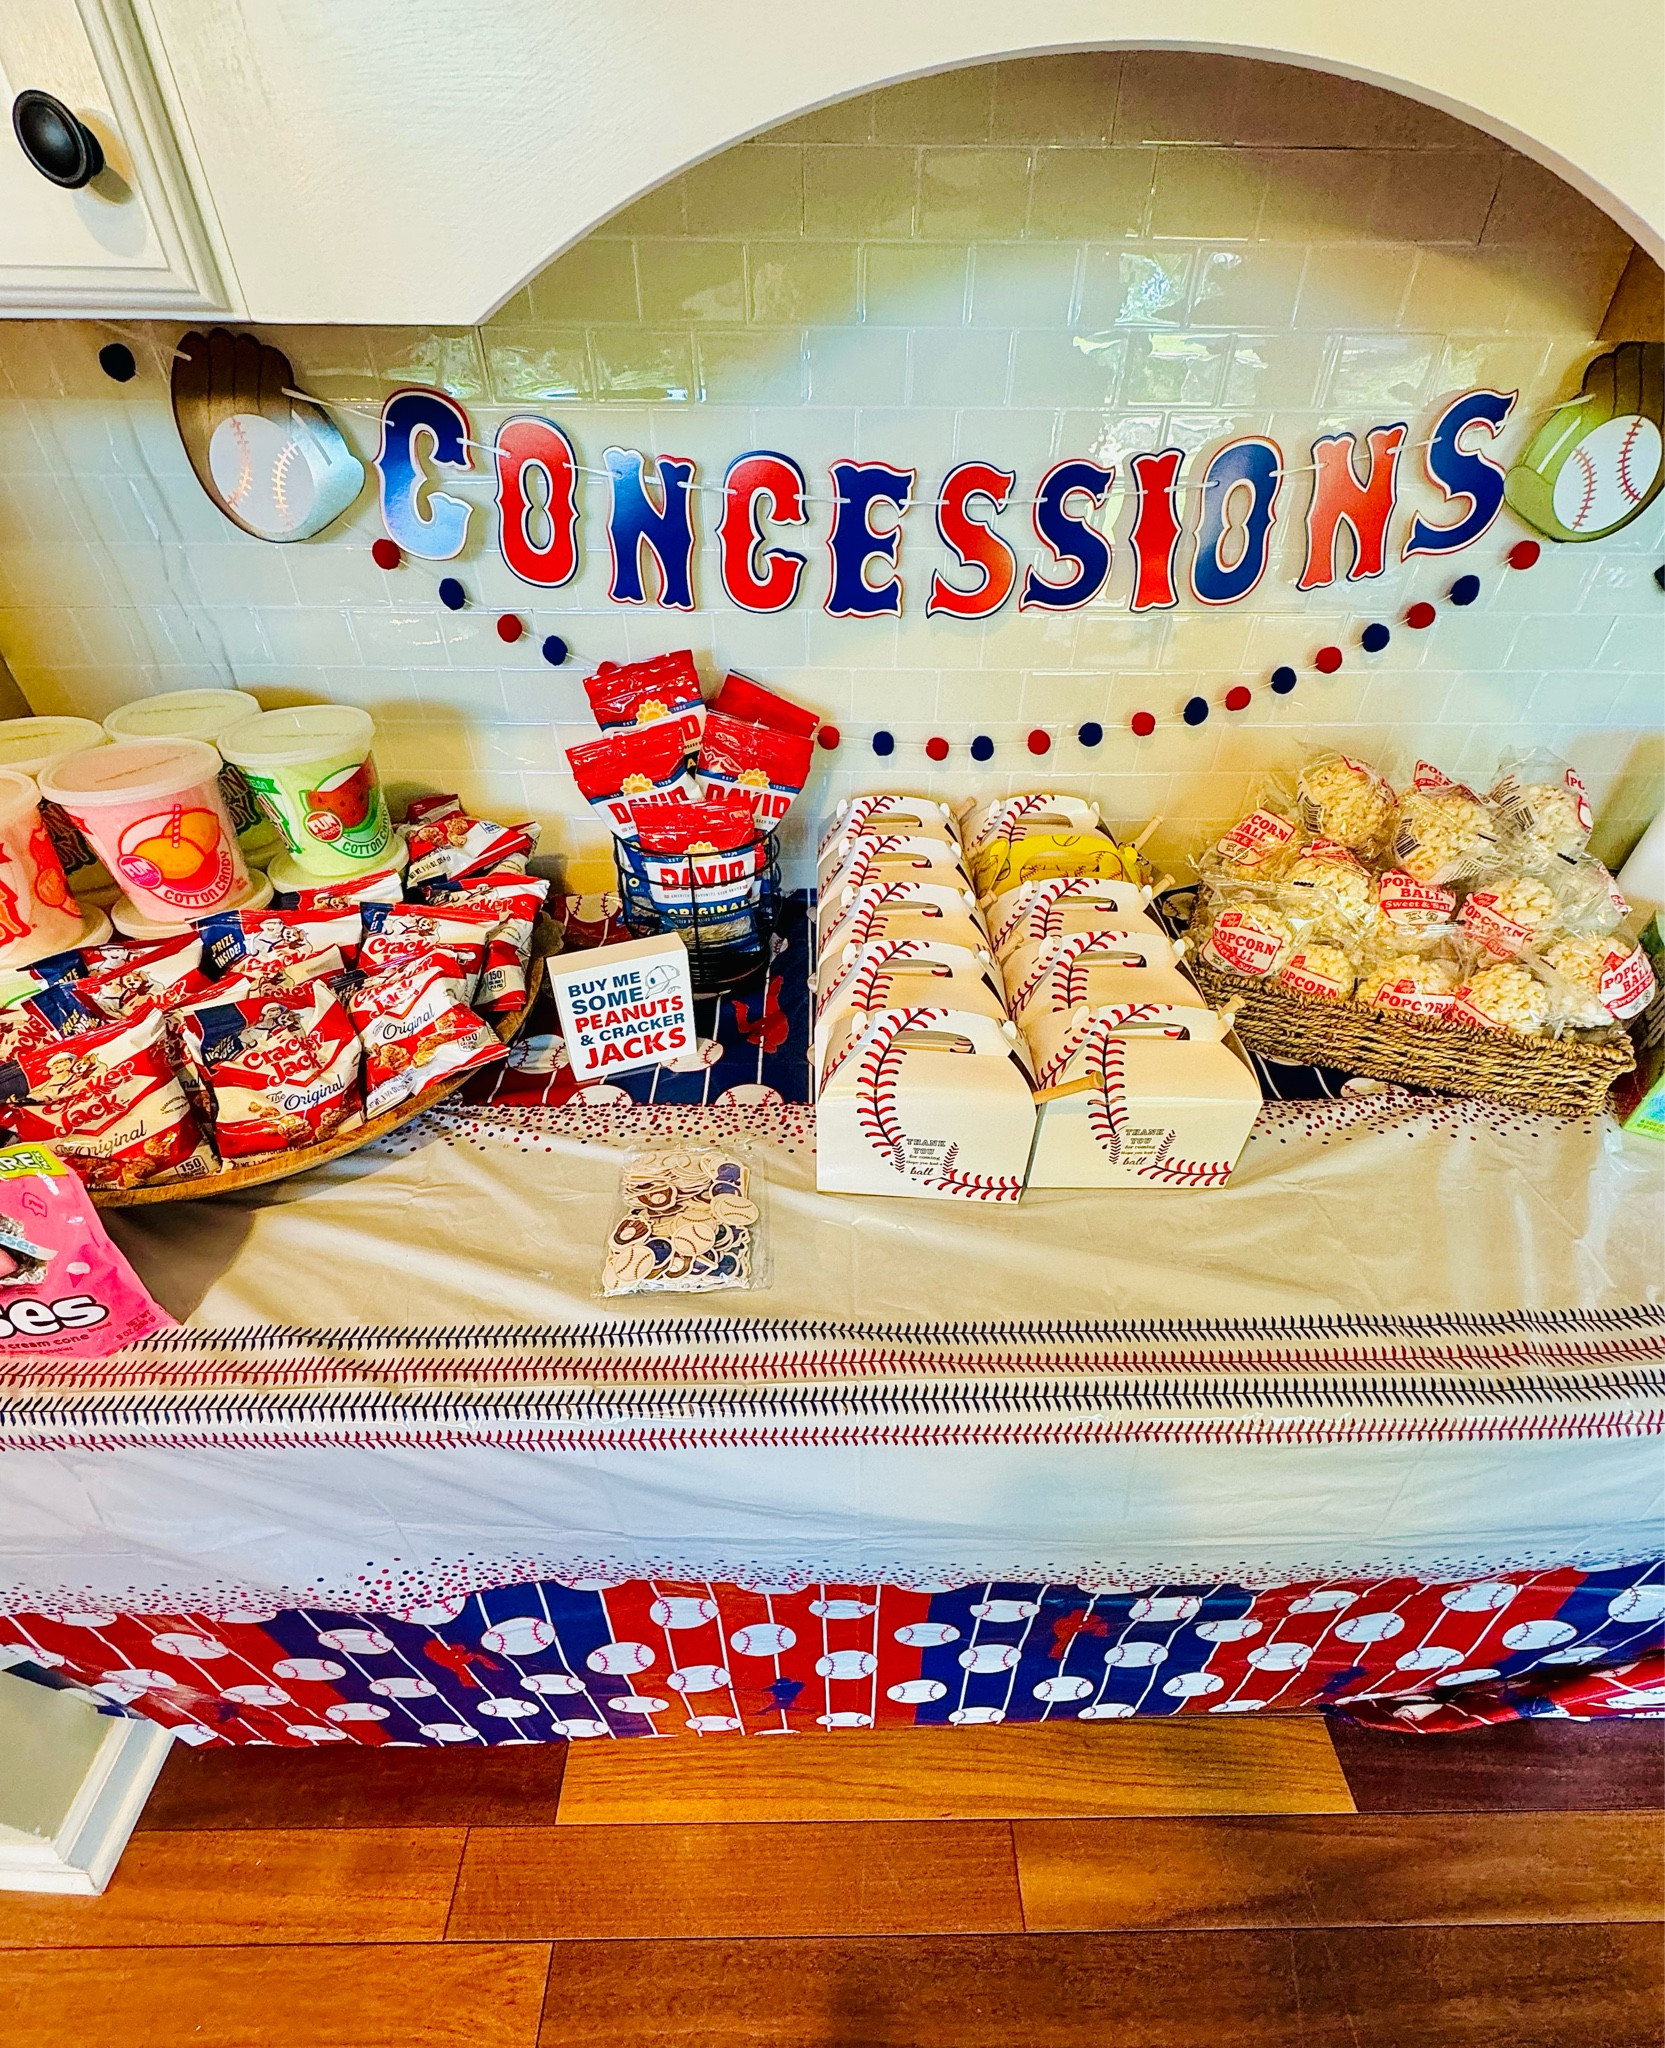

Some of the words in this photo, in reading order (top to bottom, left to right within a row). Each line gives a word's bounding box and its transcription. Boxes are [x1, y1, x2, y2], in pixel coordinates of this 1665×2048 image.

[373, 386, 1518, 619] CONCESSIONS
[307, 814, 336, 834] FUN
[342, 838, 384, 855] COTTON
[164, 888, 220, 905] COTTON
[215, 851, 233, 891] CANDY
[660, 860, 746, 890] DAVID
[1401, 888, 1443, 901] BALL
[667, 900, 749, 918] ORGINAL
[211, 934, 235, 959] PRIZE
[368, 937, 436, 955] Crack
[1214, 927, 1276, 956] POPCORN
[214, 942, 242, 969] INSIDE!
[489, 970, 502, 980] 150
[568, 978, 607, 997] BUY
[613, 971, 641, 988] ME
[571, 986, 643, 1015] SOME
[383, 1004, 436, 1040] Original
[575, 996, 684, 1034] PEANUTS
[580, 1035, 595, 1046] &
[599, 1013, 685, 1041] CRACKER
[243, 1028, 325, 1070] Cracker
[585, 1027, 686, 1069] JACKS
[267, 1050, 323, 1087] Jack
[266, 1091, 287, 1104] The
[284, 1074, 345, 1111] Original
[54, 1094, 124, 1138] Jack
[73, 1119, 149, 1159] Original
[906, 1138, 946, 1147] THANK
[1125, 1128, 1165, 1136] THANK
[179, 1158, 202, 1172] 150
[910, 1167, 934, 1176] ball
[1123, 1157, 1147, 1165] ball
[87, 1321, 113, 1333] brand
[126, 1316, 141, 1328] NET
[140, 1309, 151, 1319] WT
[7, 1339, 50, 1350] cream
[53, 1333, 90, 1345] cone
